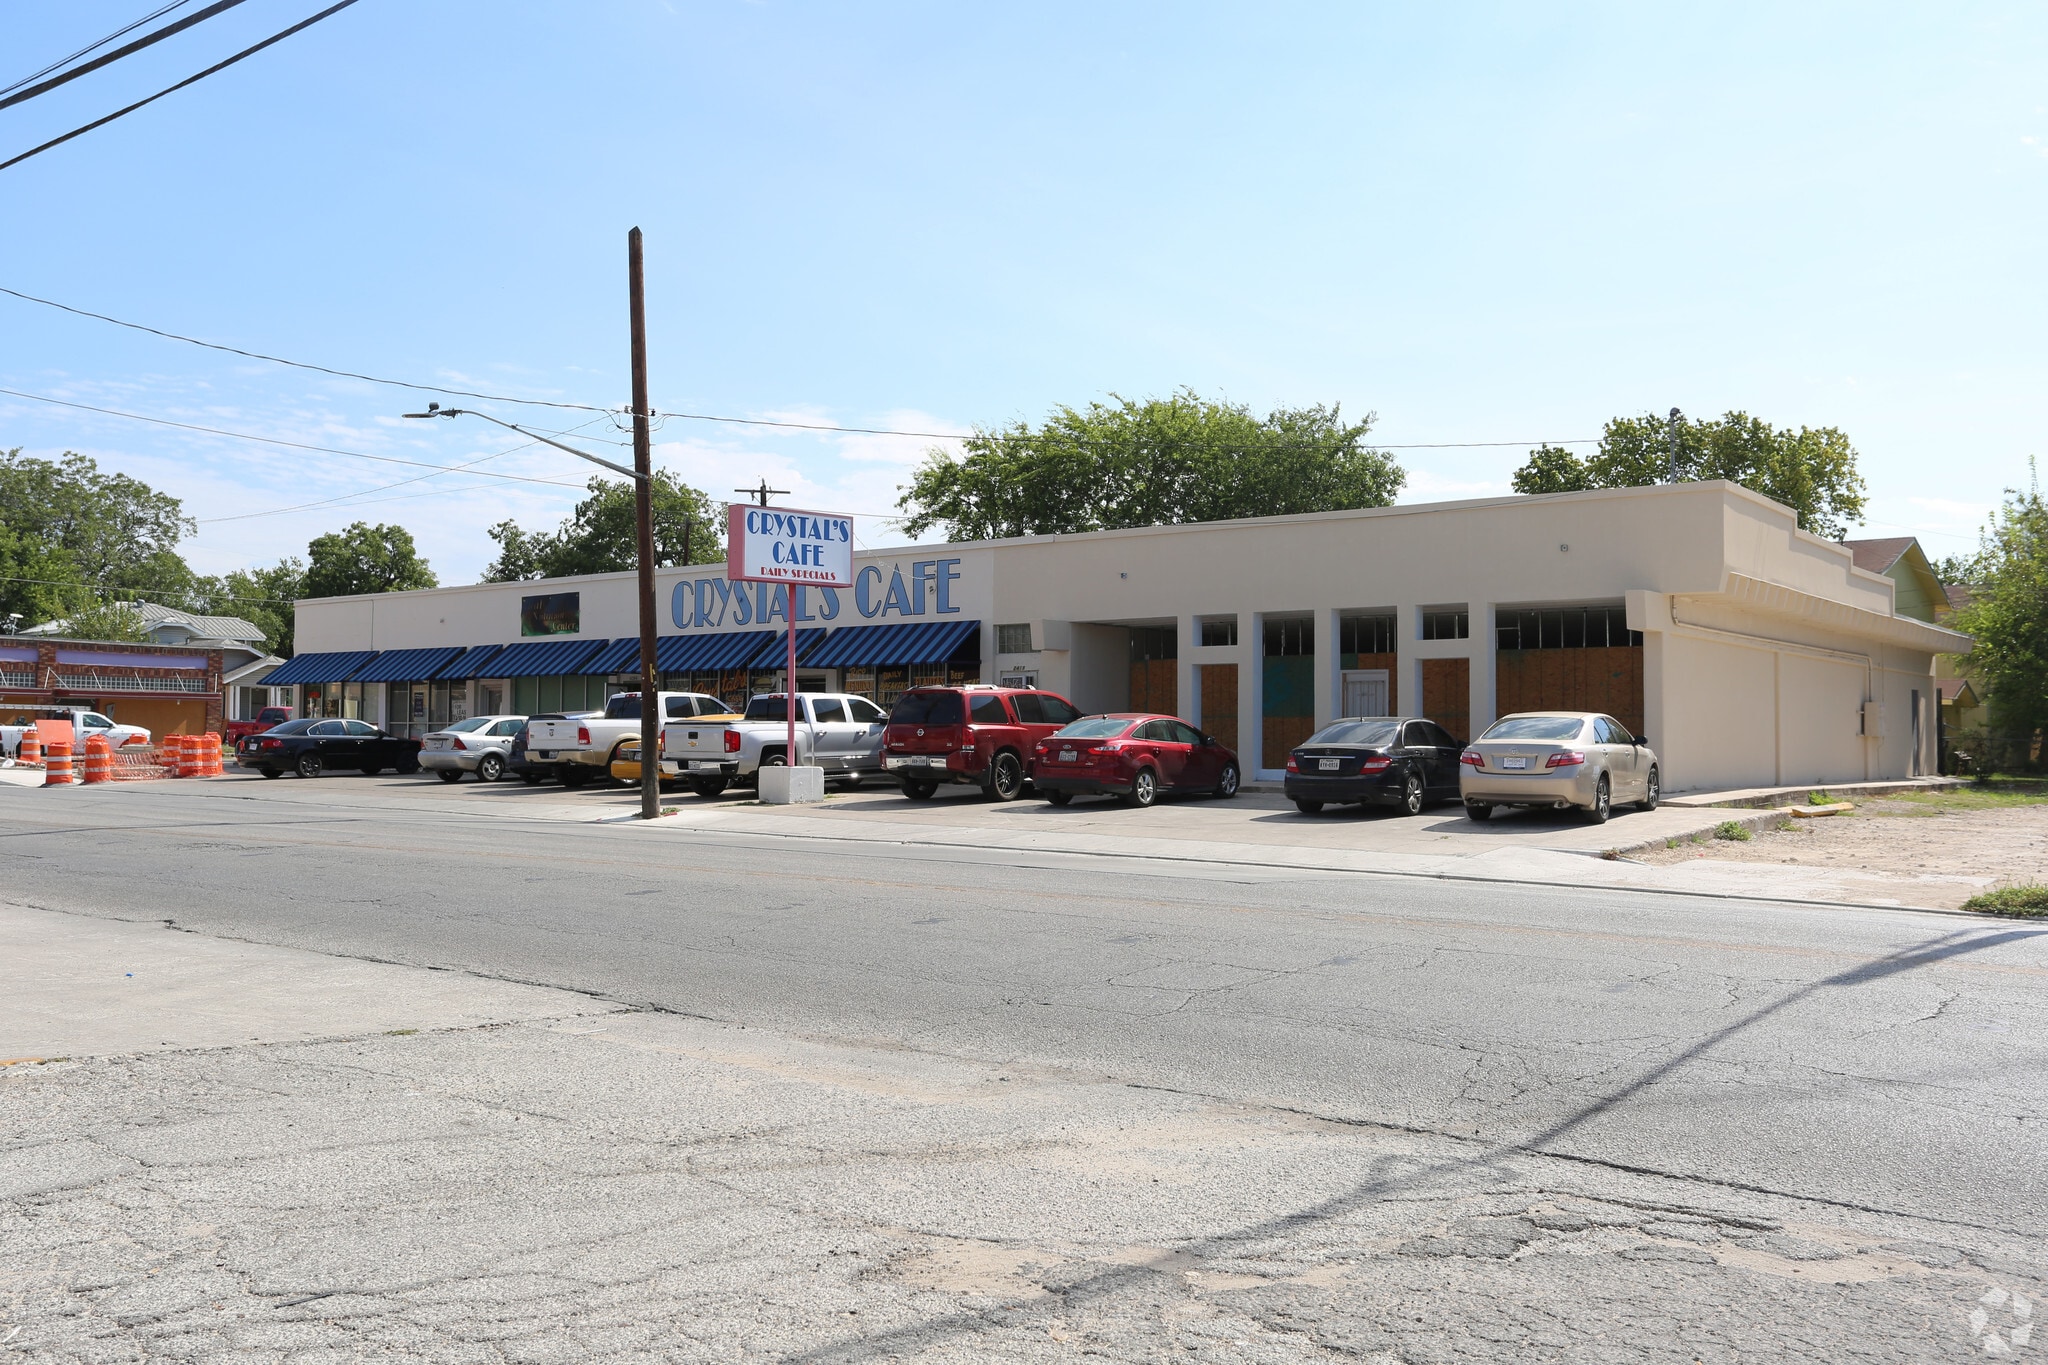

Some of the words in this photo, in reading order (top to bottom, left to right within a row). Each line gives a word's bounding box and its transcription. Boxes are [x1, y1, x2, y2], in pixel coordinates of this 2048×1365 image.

[747, 510, 849, 543] CRYSTAL'S
[772, 541, 824, 567] CAFE
[760, 566, 788, 577] DAILY
[791, 569, 836, 581] SPECIALS
[671, 577, 841, 630] CRYSTALS
[854, 558, 961, 619] CAFE
[883, 670, 903, 681] DAILY
[950, 670, 965, 680] BEEF
